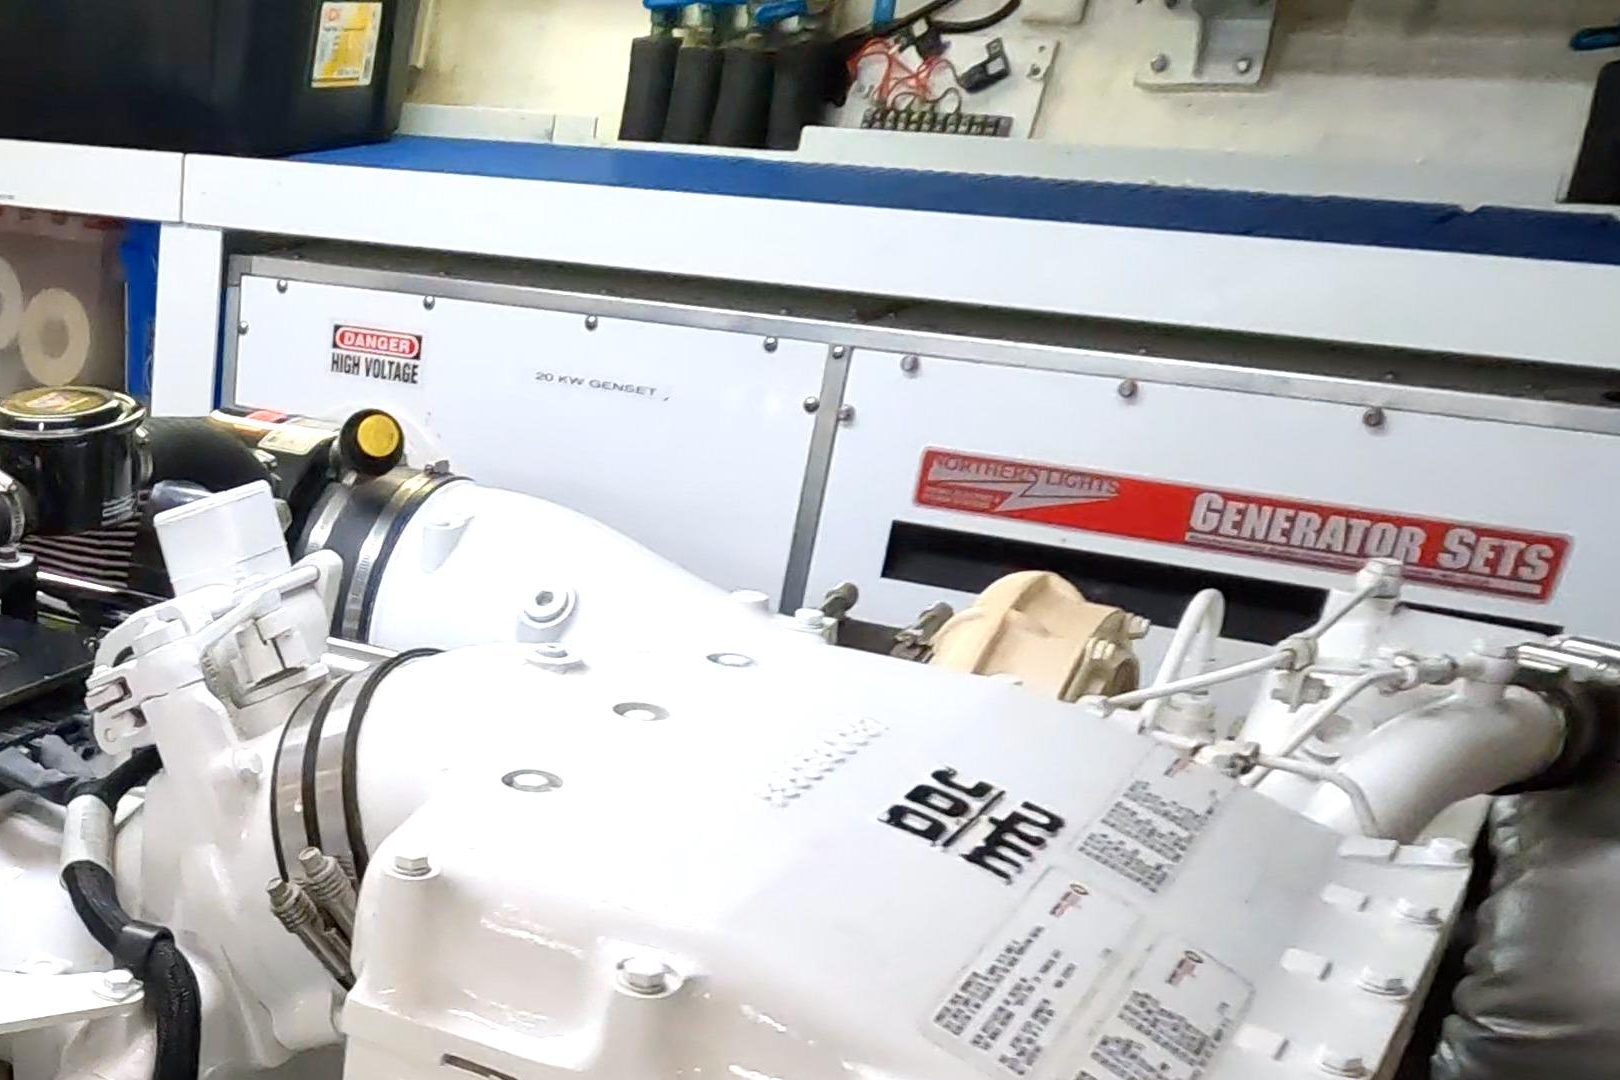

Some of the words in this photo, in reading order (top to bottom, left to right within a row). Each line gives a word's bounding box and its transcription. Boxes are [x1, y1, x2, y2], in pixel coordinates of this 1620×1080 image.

[343, 331, 411, 354] DANGER
[331, 352, 361, 375] HIGH
[365, 357, 419, 384] VOLTAGE
[535, 371, 554, 383] 20
[558, 375, 585, 386] KW
[588, 379, 657, 396] GENSET
[877, 765, 995, 848] DDC
[959, 800, 1067, 887] mtu
